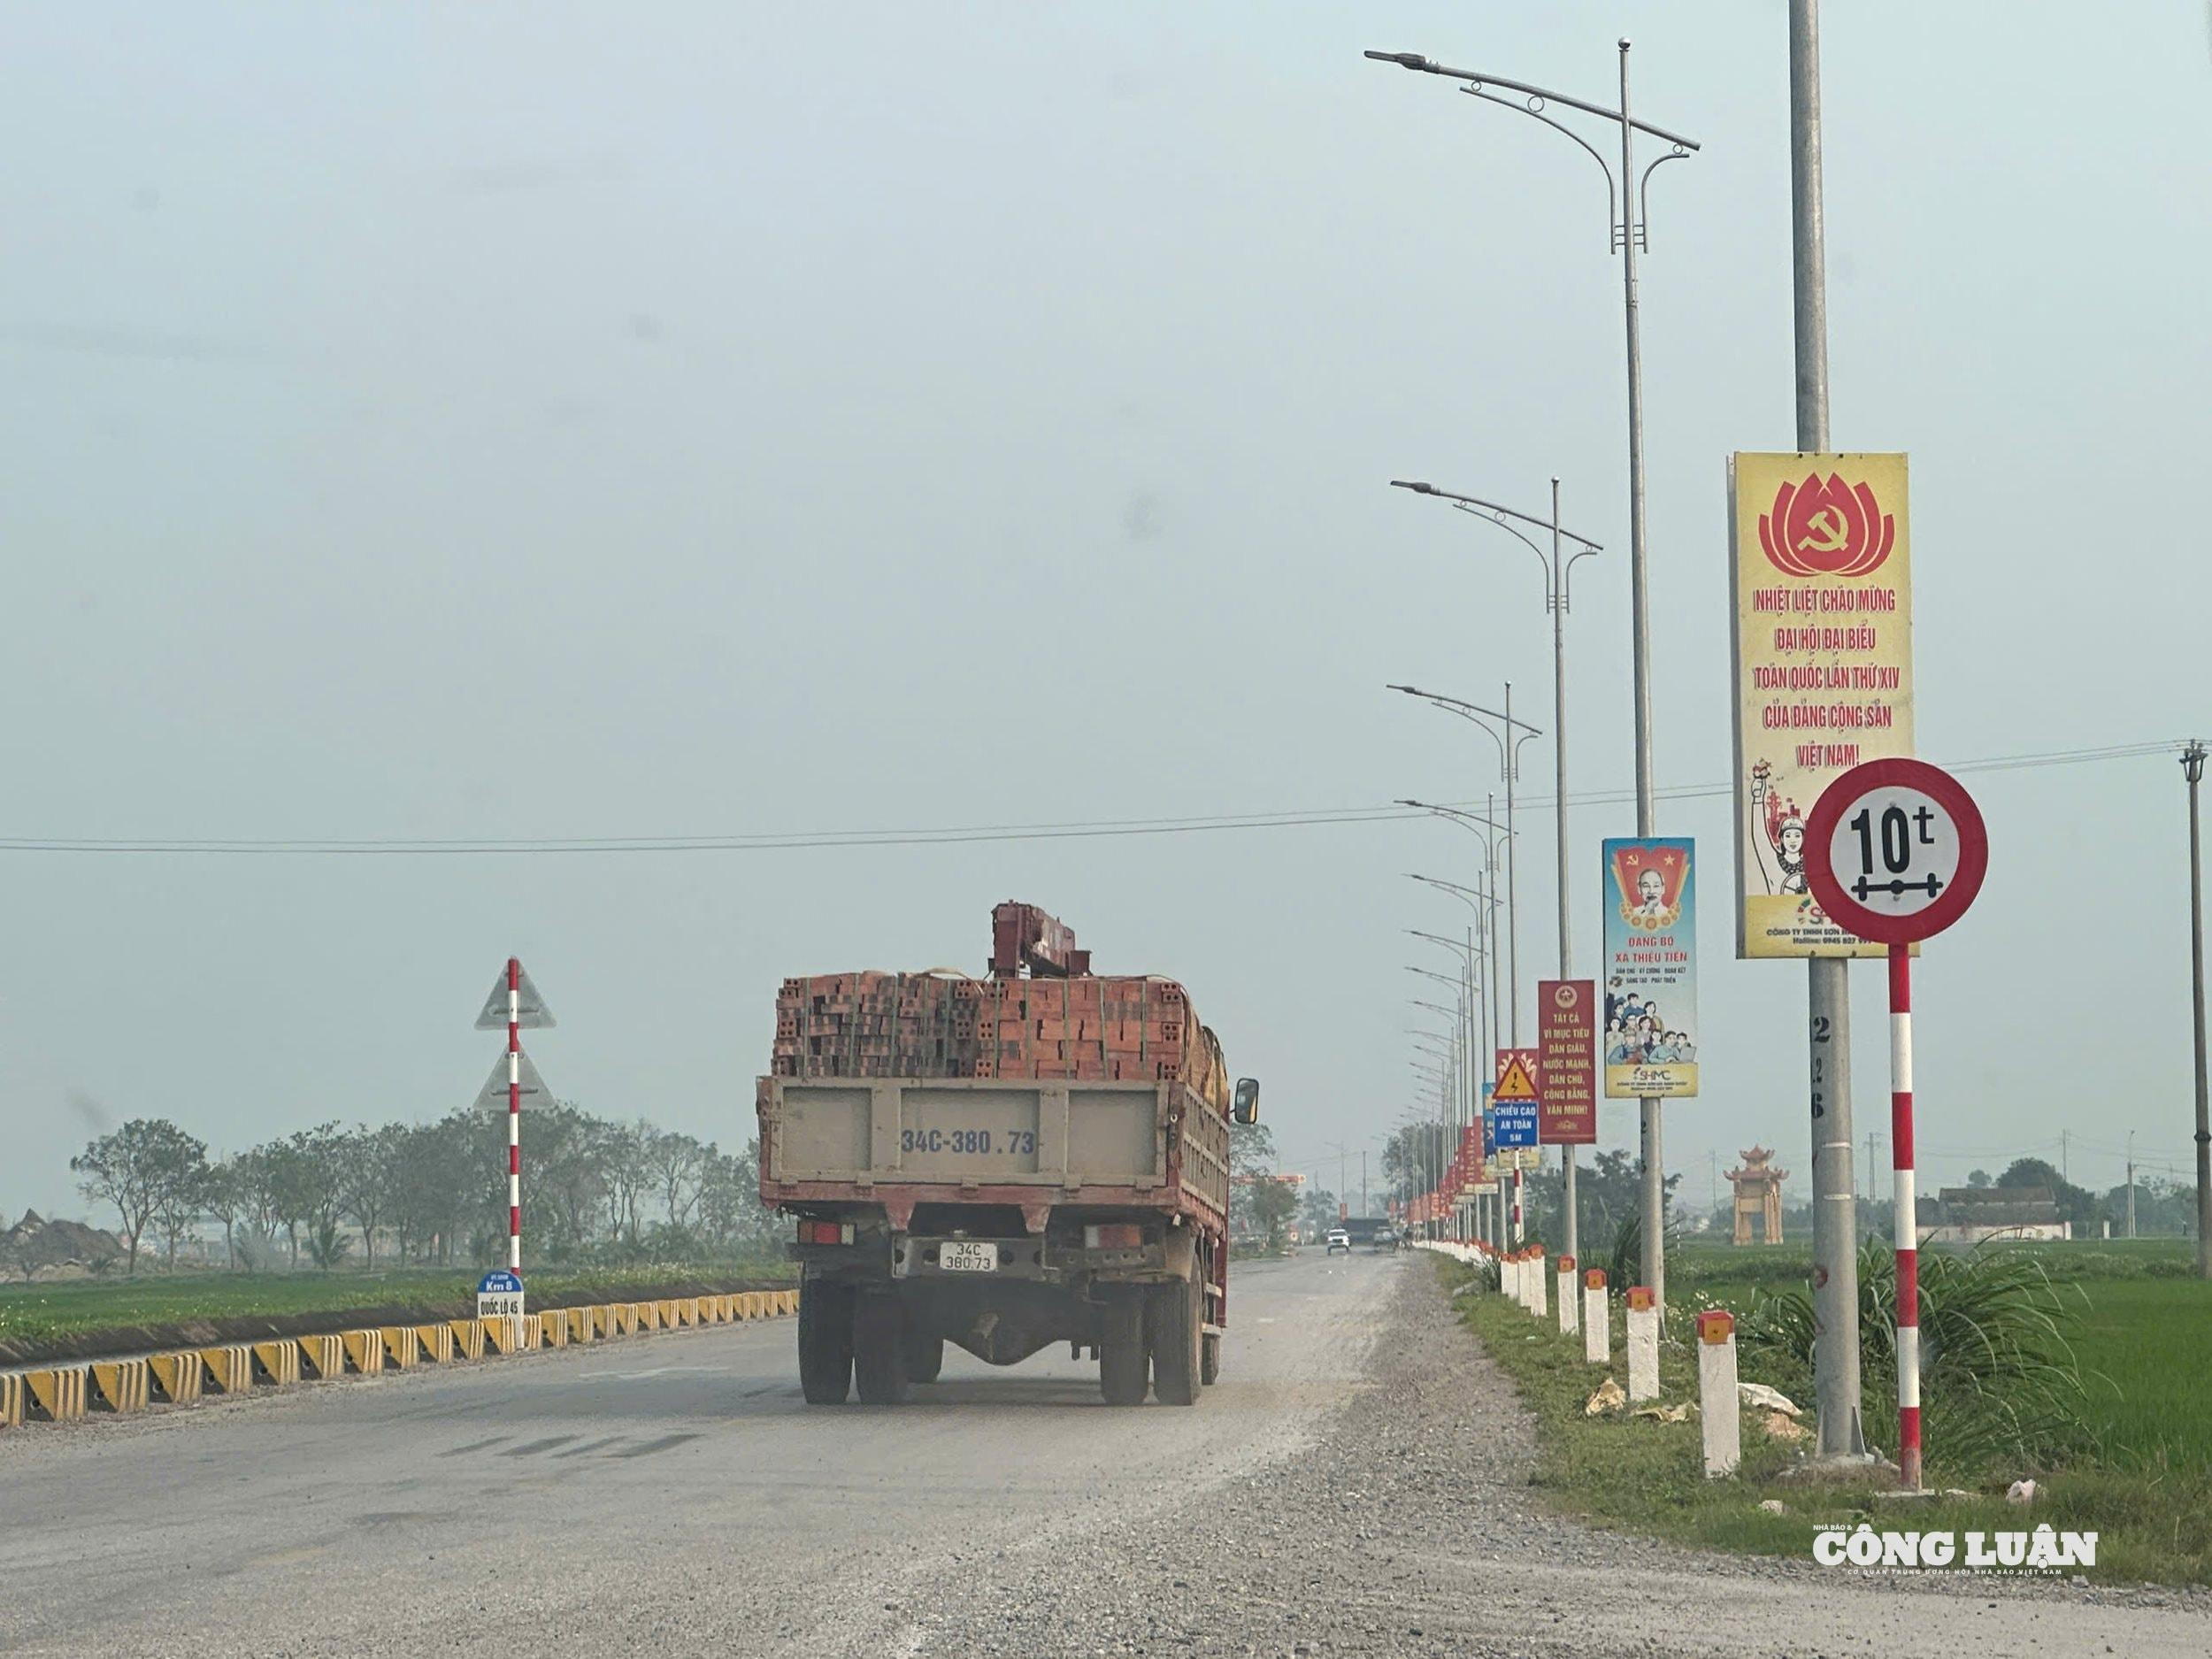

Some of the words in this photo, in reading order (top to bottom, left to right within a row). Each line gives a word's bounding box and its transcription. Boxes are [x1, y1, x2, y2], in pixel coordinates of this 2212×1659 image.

[1755, 586, 1791, 616] NHIỆT
[1793, 586, 1818, 616] LIỆT
[1821, 585, 1855, 611] CHÀO
[1857, 585, 1895, 611] MỪNG
[1776, 627, 1797, 656] ĐẠI
[1800, 624, 1821, 656] HỘI
[1823, 627, 1845, 656] ĐẠI
[1847, 619, 1876, 649] BIỂU
[1755, 663, 1787, 689] TOÀN
[1790, 659, 1823, 691] QUỐC
[1853, 663, 1877, 689] THỨ
[1878, 666, 1900, 689] XIV
[1763, 698, 1789, 728] CỦA
[1793, 698, 1826, 728] ĐẢNG
[1830, 701, 1863, 733] CỘNG
[1866, 698, 1892, 728] SẢN
[1797, 741, 1824, 772] VIỆT
[1825, 743, 1859, 767] NAM!
[1520, 1106, 1536, 1116] CAO
[1500, 1120, 1511, 1130] AN
[1513, 1118, 1532, 1130] TOÀN
[956, 1243, 981, 1256] 34C
[945, 1256, 991, 1270] 380.73
[486, 1281, 504, 1291] Km
[480, 1296, 499, 1316] QUỐC
[500, 1298, 509, 1317] LỘ
[510, 1301, 518, 1315] 45
